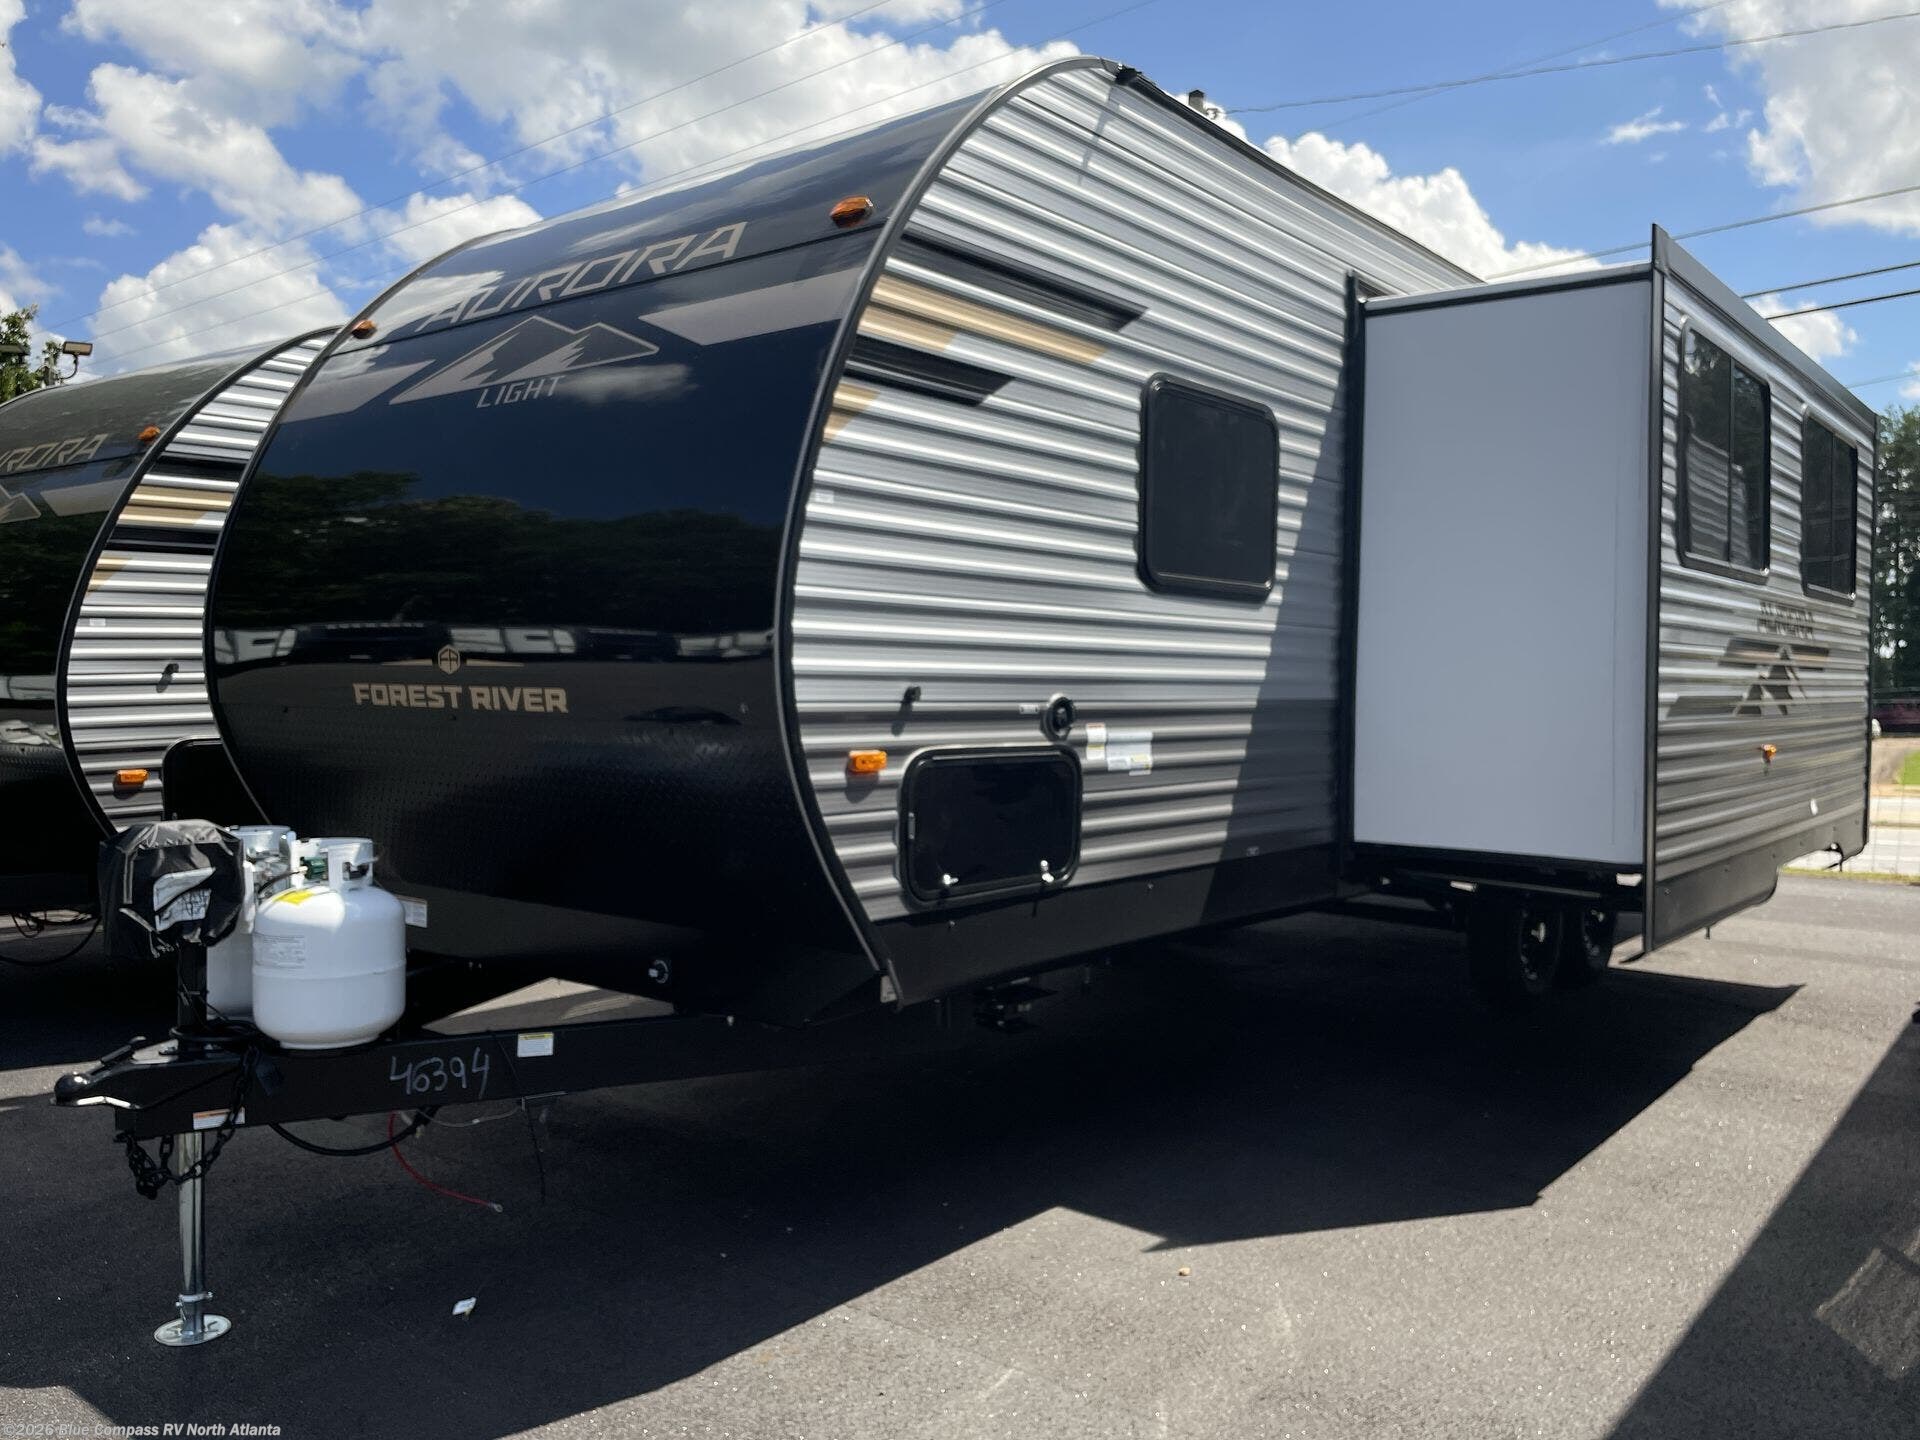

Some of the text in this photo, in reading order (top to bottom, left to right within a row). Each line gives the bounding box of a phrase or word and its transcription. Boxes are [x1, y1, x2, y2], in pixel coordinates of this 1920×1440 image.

[415, 221, 748, 332] AURORA
[476, 375, 566, 408] LIGHT
[352, 682, 570, 714] FOREST RIVER
[389, 1046, 490, 1101] 46394
